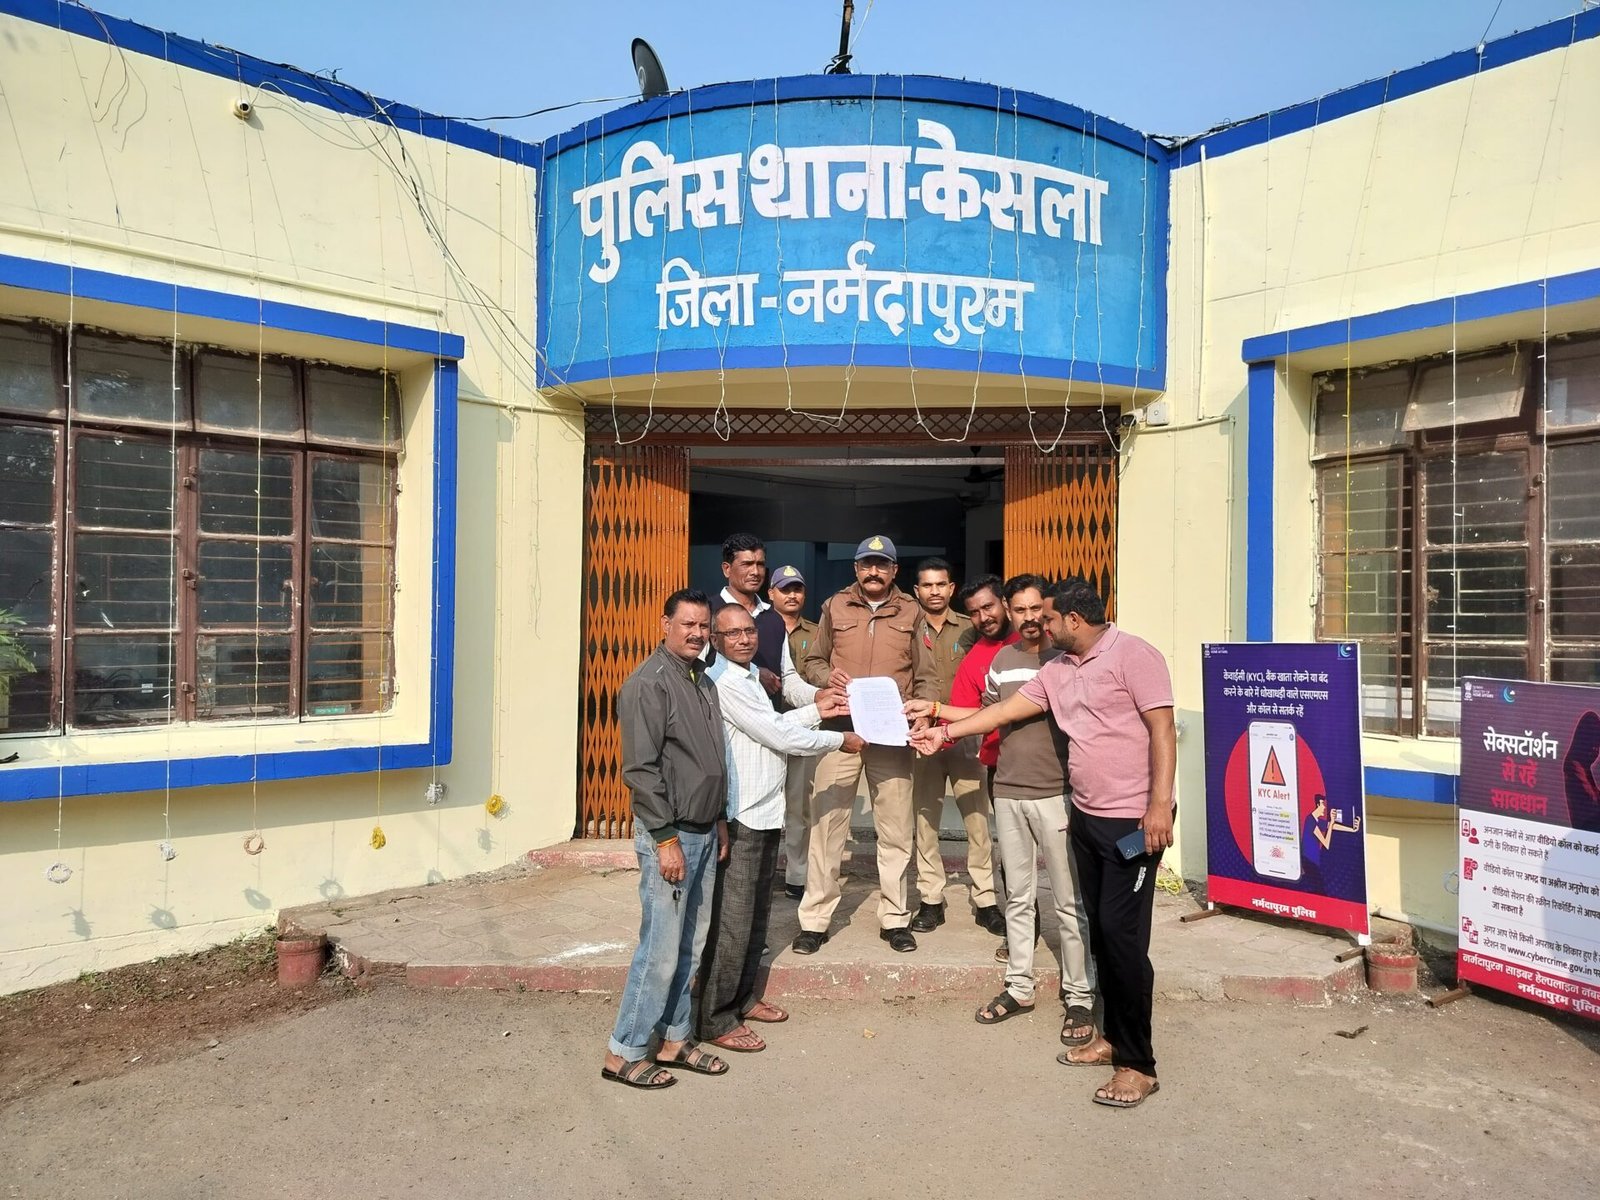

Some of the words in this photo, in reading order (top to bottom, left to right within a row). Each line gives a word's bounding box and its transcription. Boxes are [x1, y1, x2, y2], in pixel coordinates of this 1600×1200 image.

[572, 140, 742, 283] पुलिस
[1223, 668, 1245, 682] केवाईसी
[1246, 672, 1266, 684] (KYC),
[1277, 671, 1293, 682] खाता
[1293, 670, 1309, 683] रोकने
[1310, 673, 1318, 683] या
[1319, 671, 1328, 684] बंद
[1223, 685, 1237, 697] करने
[1237, 686, 1243, 697] के
[1244, 685, 1253, 697] बारे
[1286, 687, 1298, 699] वाले
[1299, 690, 1328, 701] एसएमएस
[1246, 702, 1257, 714] और
[1258, 702, 1271, 714] कॉल
[1272, 703, 1278, 715] से
[1279, 704, 1295, 716] सतर्क
[1482, 726, 1558, 760] सेक्सटॉर्शन
[1501, 756, 1516, 782] से
[1257, 788, 1271, 799] KYC
[1273, 790, 1290, 801] Alert
[1491, 788, 1548, 816] सावधान
[1483, 825, 1503, 837] अनजान
[1518, 829, 1524, 840] से
[1537, 832, 1557, 846] वीडियो
[1557, 838, 1573, 850] कॉल
[1573, 841, 1583, 852] को
[1583, 844, 1600, 856] कतई
[1483, 838, 1494, 849] ठगी
[1495, 839, 1501, 849] के
[1502, 842, 1519, 854] शिकार
[1520, 845, 1527, 856] हो
[1527, 847, 1543, 859] सकते
[1483, 861, 1501, 874] वीडियो
[1501, 866, 1515, 877] कॉल
[1515, 871, 1523, 880] पर
[1524, 872, 1539, 884] अभद्र
[1539, 876, 1547, 885] या
[1568, 881, 1589, 895] अनुरोध
[1590, 884, 1600, 896] को
[1252, 897, 1289, 914] नर्मदापुरम
[1291, 905, 1316, 918] पुलिस
[1491, 885, 1510, 899] वीडियो
[1510, 890, 1525, 902] सेशन
[1526, 893, 1534, 905] की
[1576, 904, 1583, 916] से
[1491, 901, 1499, 910] जा
[1500, 903, 1518, 915] सकता
[1483, 924, 1496, 935] अगर
[1496, 928, 1508, 938] आप
[1519, 931, 1534, 945] किसी
[1535, 937, 1554, 950] अपराध
[1554, 941, 1562, 952] के
[1563, 943, 1582, 958] शिकार
[1583, 950, 1592, 963] हुए
[1483, 938, 1499, 950] स्टेशन
[1499, 942, 1507, 952] या
[1507, 946, 1592, 974] www.cybercrime.gov.in
[1462, 953, 1503, 973] नर्मदापुरम
[1505, 965, 1533, 981] साइबर
[1535, 970, 1579, 994] हेल्पलाइन
[1518, 982, 1569, 1006] नर्मदापुरम
